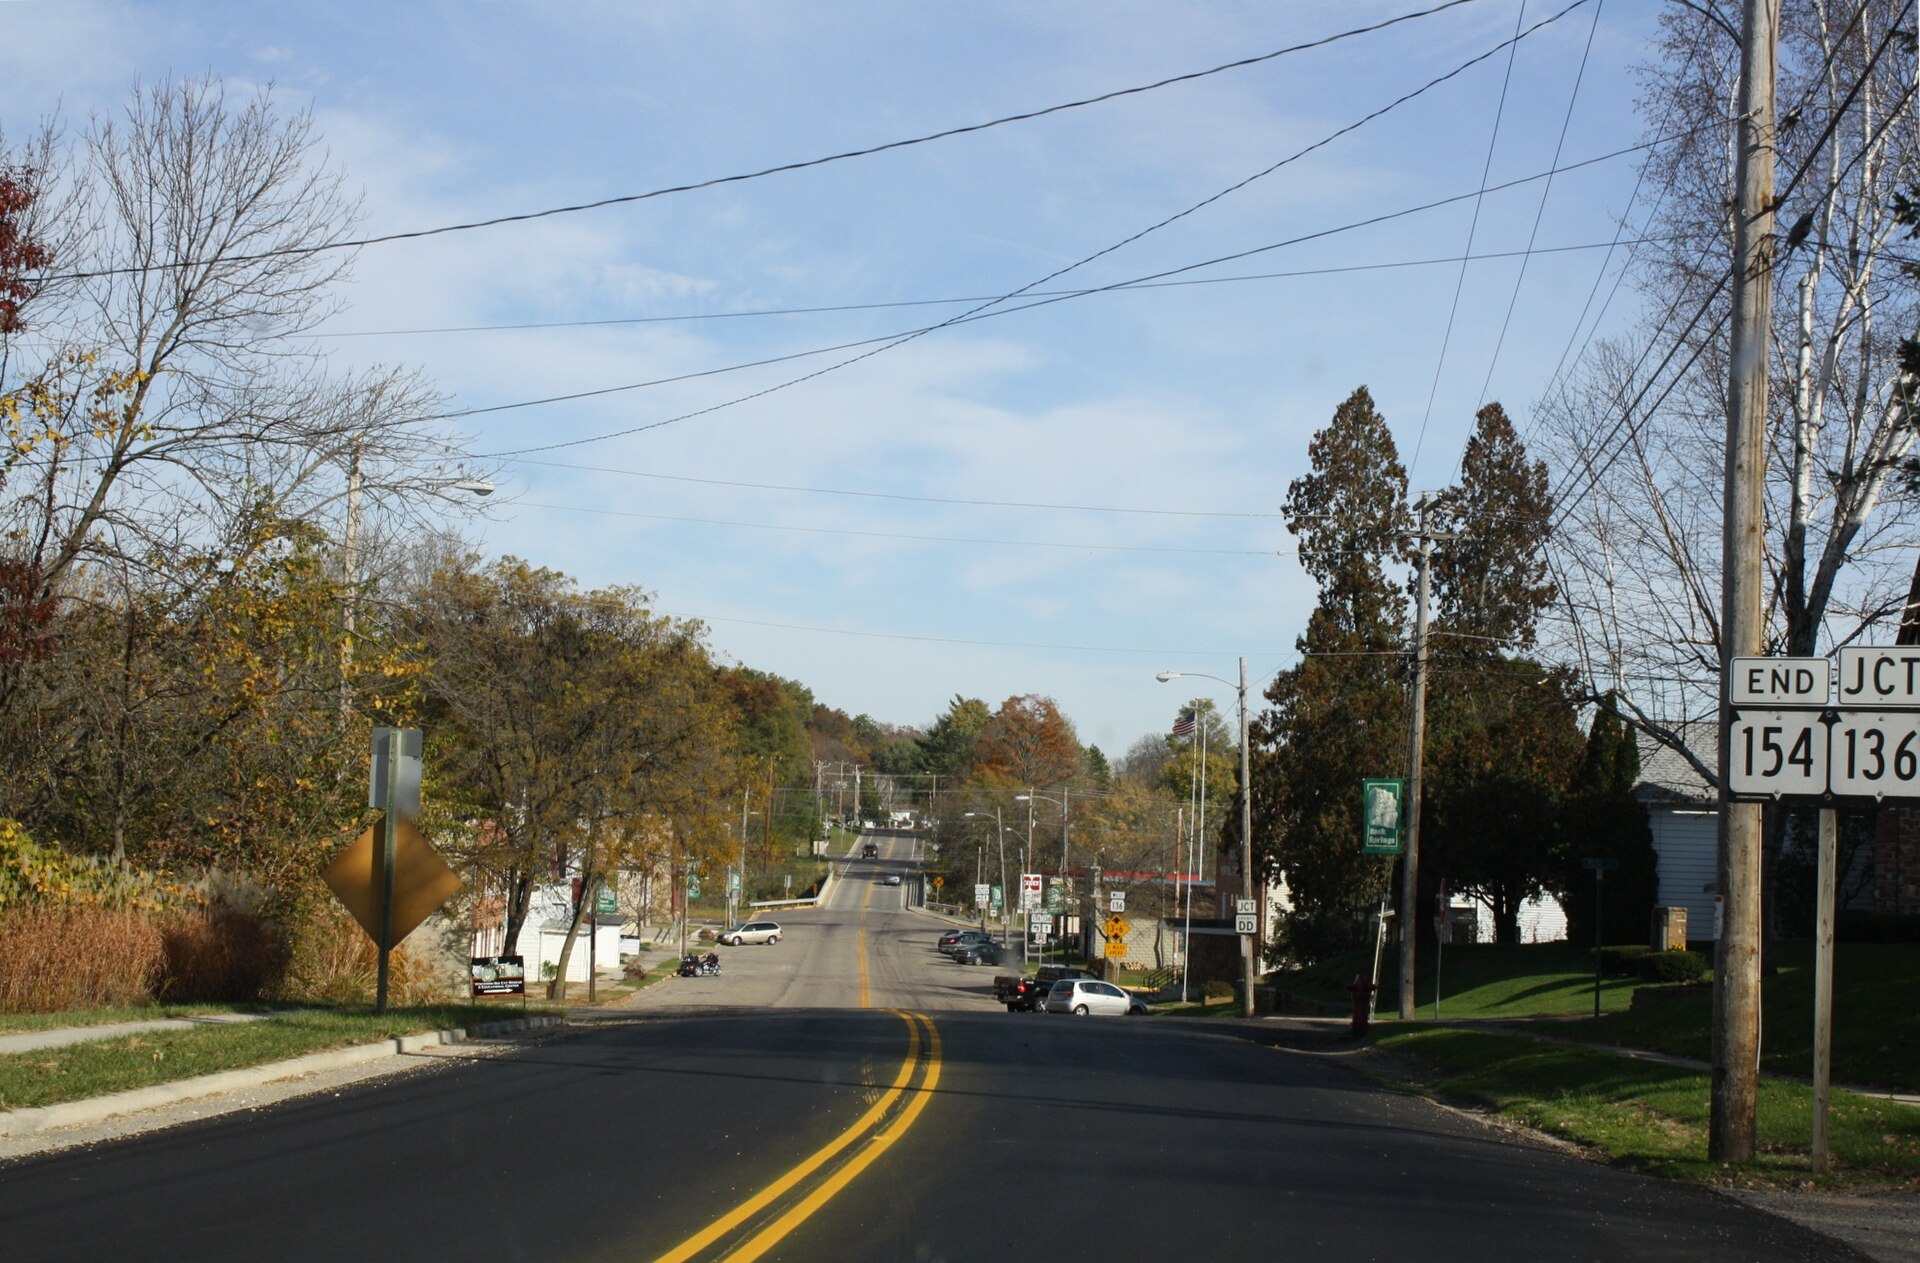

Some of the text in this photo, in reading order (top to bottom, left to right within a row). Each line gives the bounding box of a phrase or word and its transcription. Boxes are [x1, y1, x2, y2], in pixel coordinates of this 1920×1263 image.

[1748, 669, 1814, 694] END
[1844, 657, 1920, 695] JCT
[1742, 726, 1814, 778] 154
[1844, 728, 1917, 781] 136
[1112, 901, 1123, 910] 136
[1239, 902, 1255, 911] JCT
[1239, 921, 1254, 931] DD
